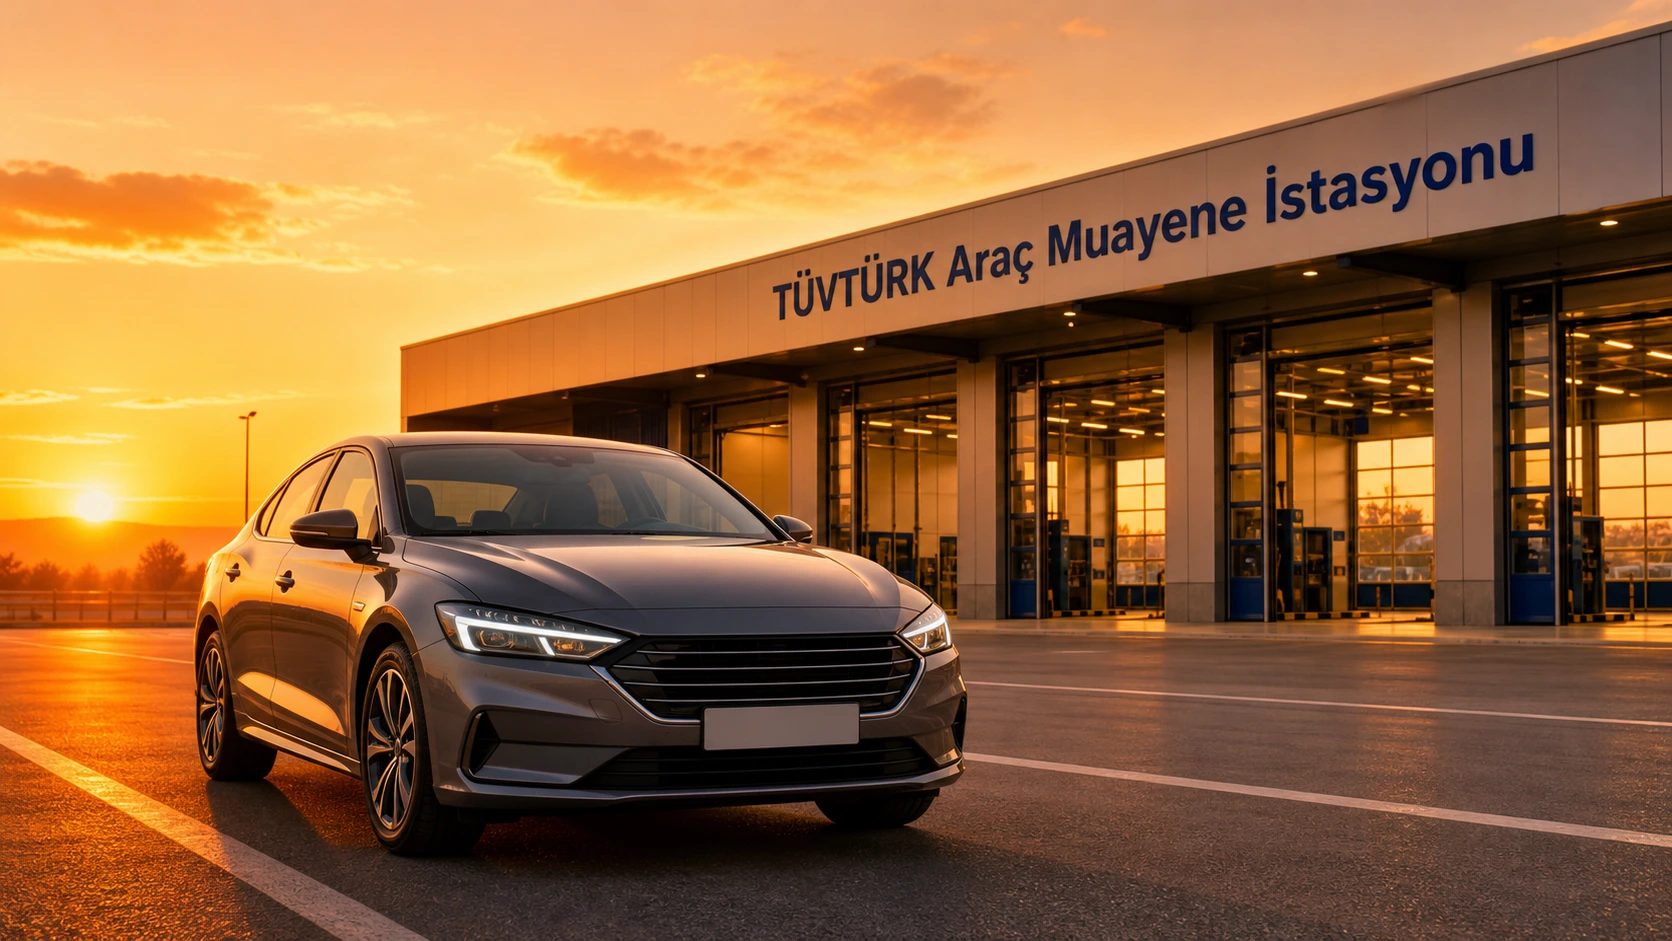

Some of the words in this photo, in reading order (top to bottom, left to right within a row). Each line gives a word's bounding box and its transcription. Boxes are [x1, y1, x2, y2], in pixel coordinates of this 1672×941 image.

[772, 251, 935, 321] TÜVTÜRK
[947, 238, 1034, 285] Araç
[1047, 194, 1247, 265] Muayene
[1265, 132, 1535, 224] İstasyonu
